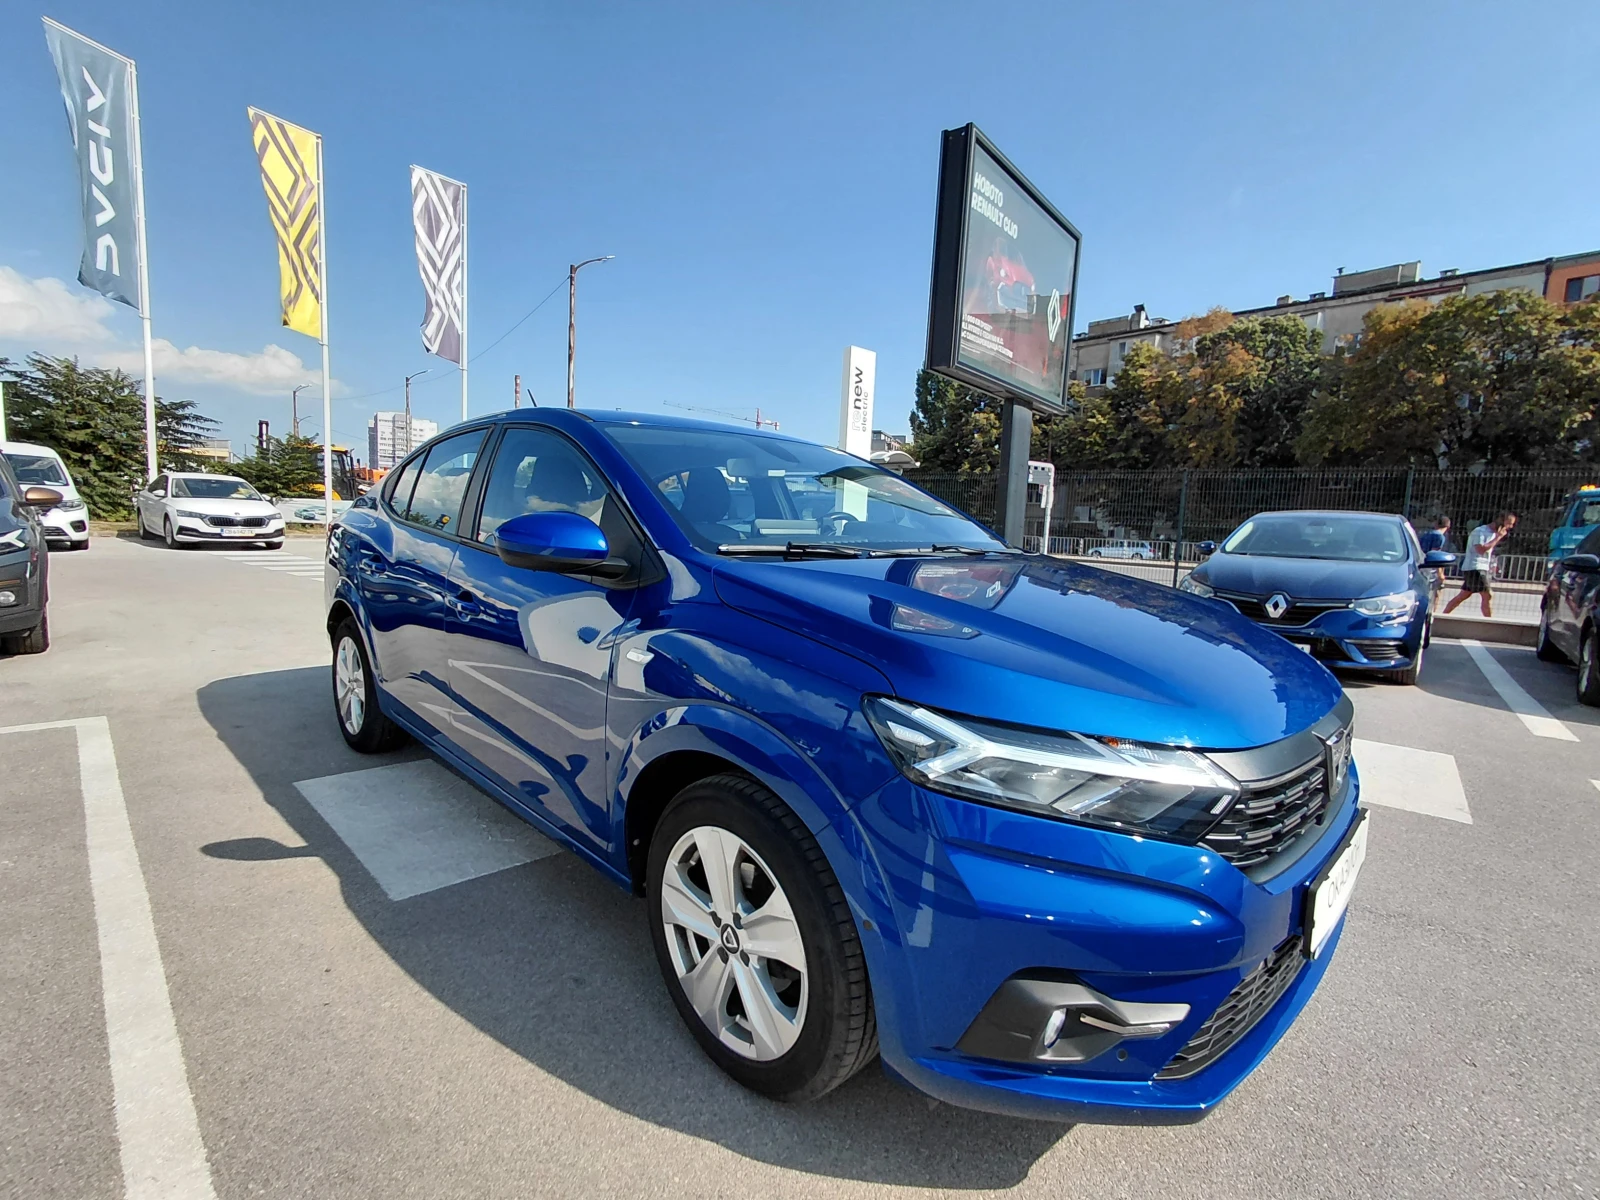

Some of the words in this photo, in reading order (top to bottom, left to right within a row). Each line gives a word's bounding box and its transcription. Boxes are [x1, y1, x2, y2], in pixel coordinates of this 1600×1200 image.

[971, 192, 1004, 228] RENAULT
[1003, 216, 1018, 240] CLIO
[861, 391, 869, 433] electric
